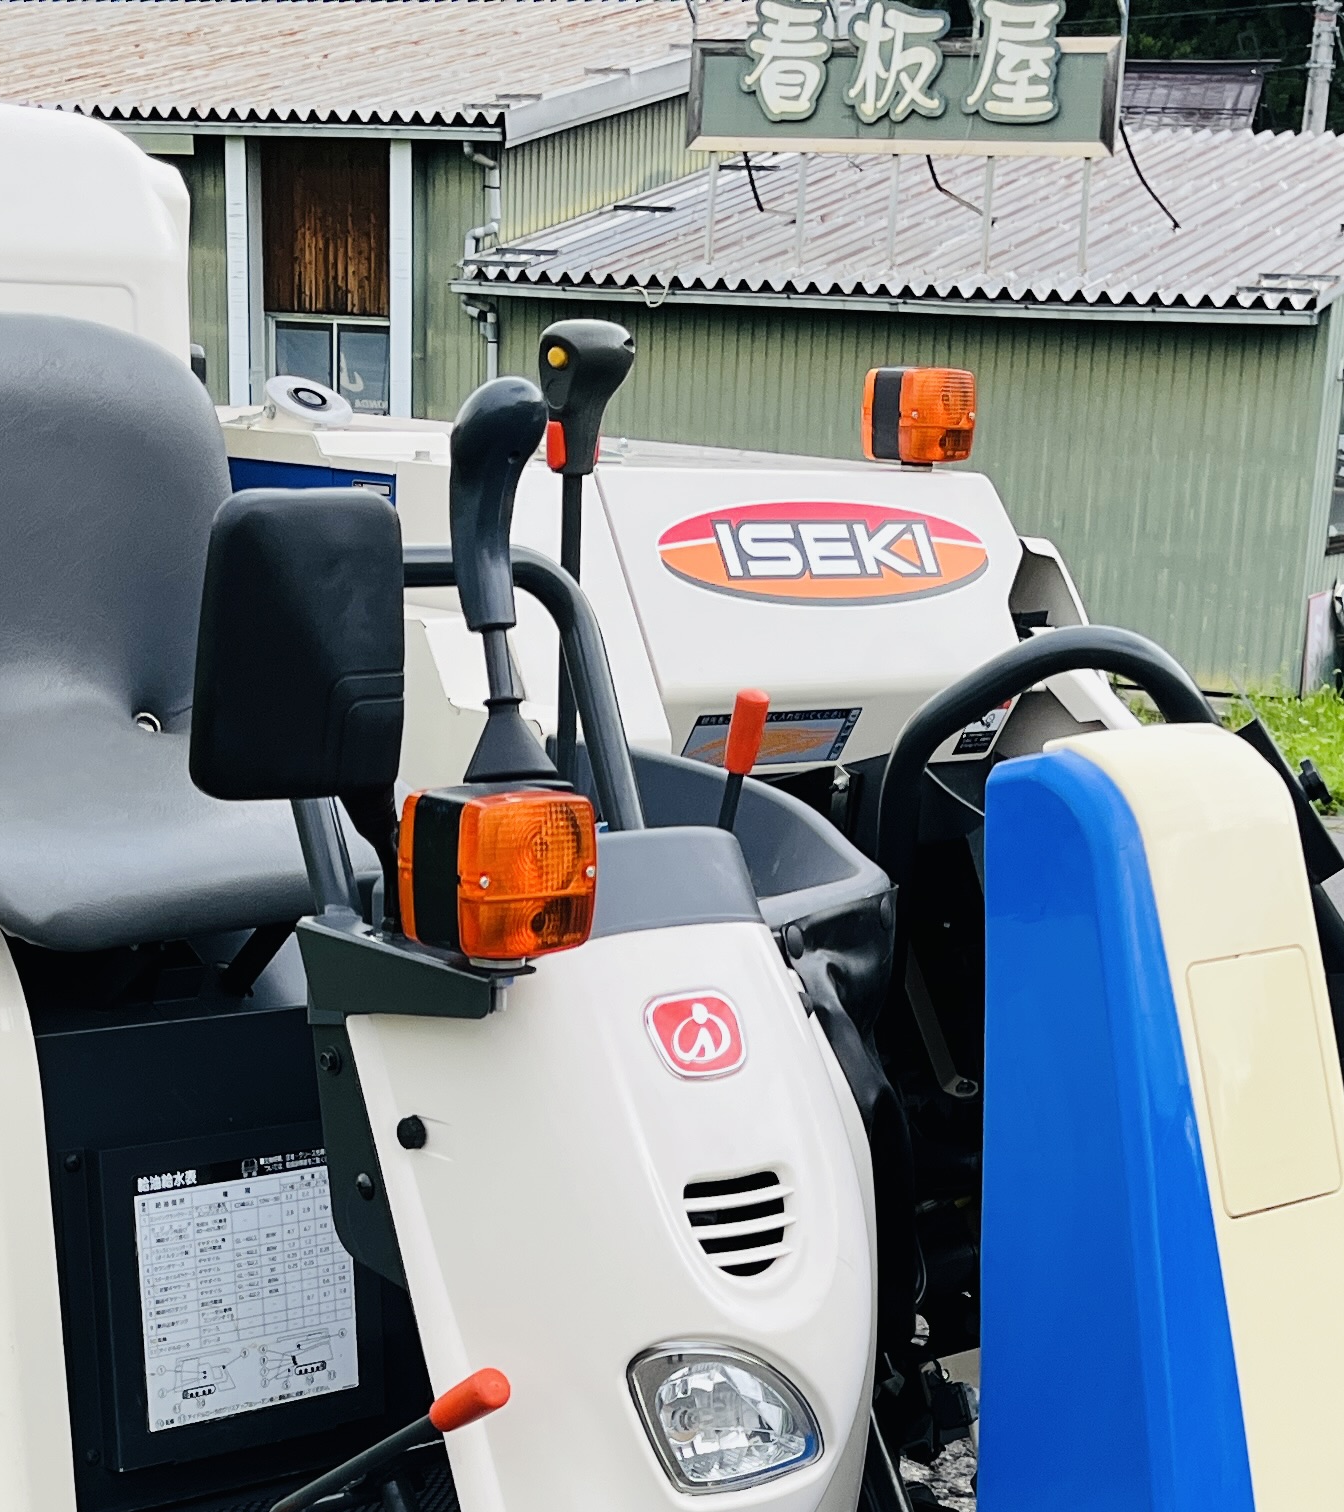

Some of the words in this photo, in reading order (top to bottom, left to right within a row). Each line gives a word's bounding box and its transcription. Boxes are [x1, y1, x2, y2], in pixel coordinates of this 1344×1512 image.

[741, 0, 1064, 121] 看板屋
[711, 519, 943, 580] ISEKI
